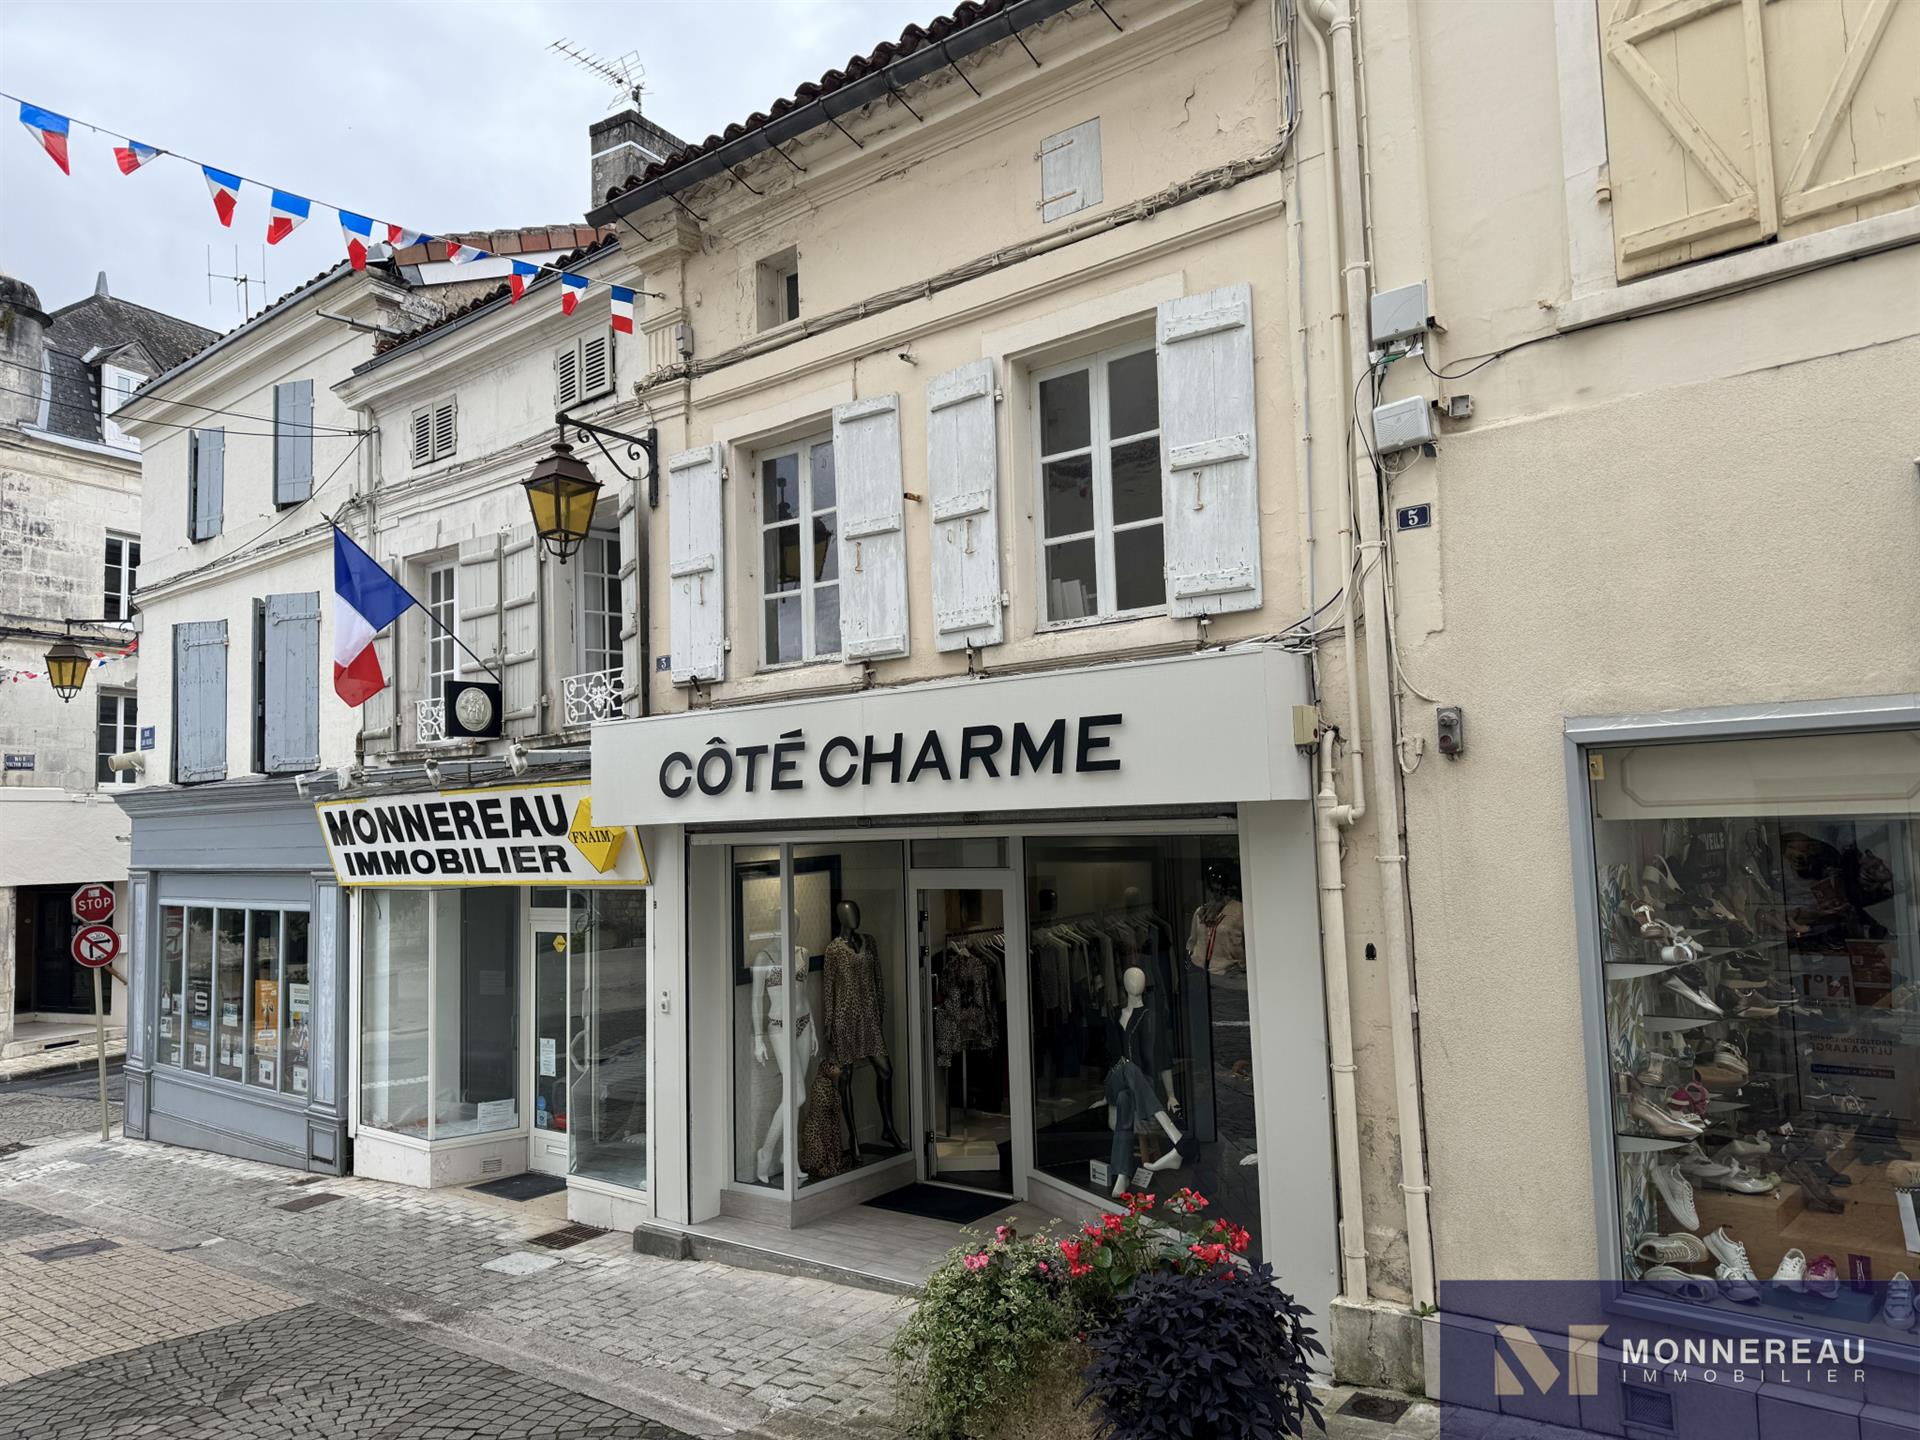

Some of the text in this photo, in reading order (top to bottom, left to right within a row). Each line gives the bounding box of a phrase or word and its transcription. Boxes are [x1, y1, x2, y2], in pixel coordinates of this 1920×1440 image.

[1408, 509, 1419, 526] 5
[659, 713, 1123, 798] CÔTÉ CHARME
[324, 793, 569, 847] MONNEREAU
[572, 830, 611, 844] FNAIM
[343, 844, 572, 876] IMMOBILIER
[78, 897, 112, 912] STOP
